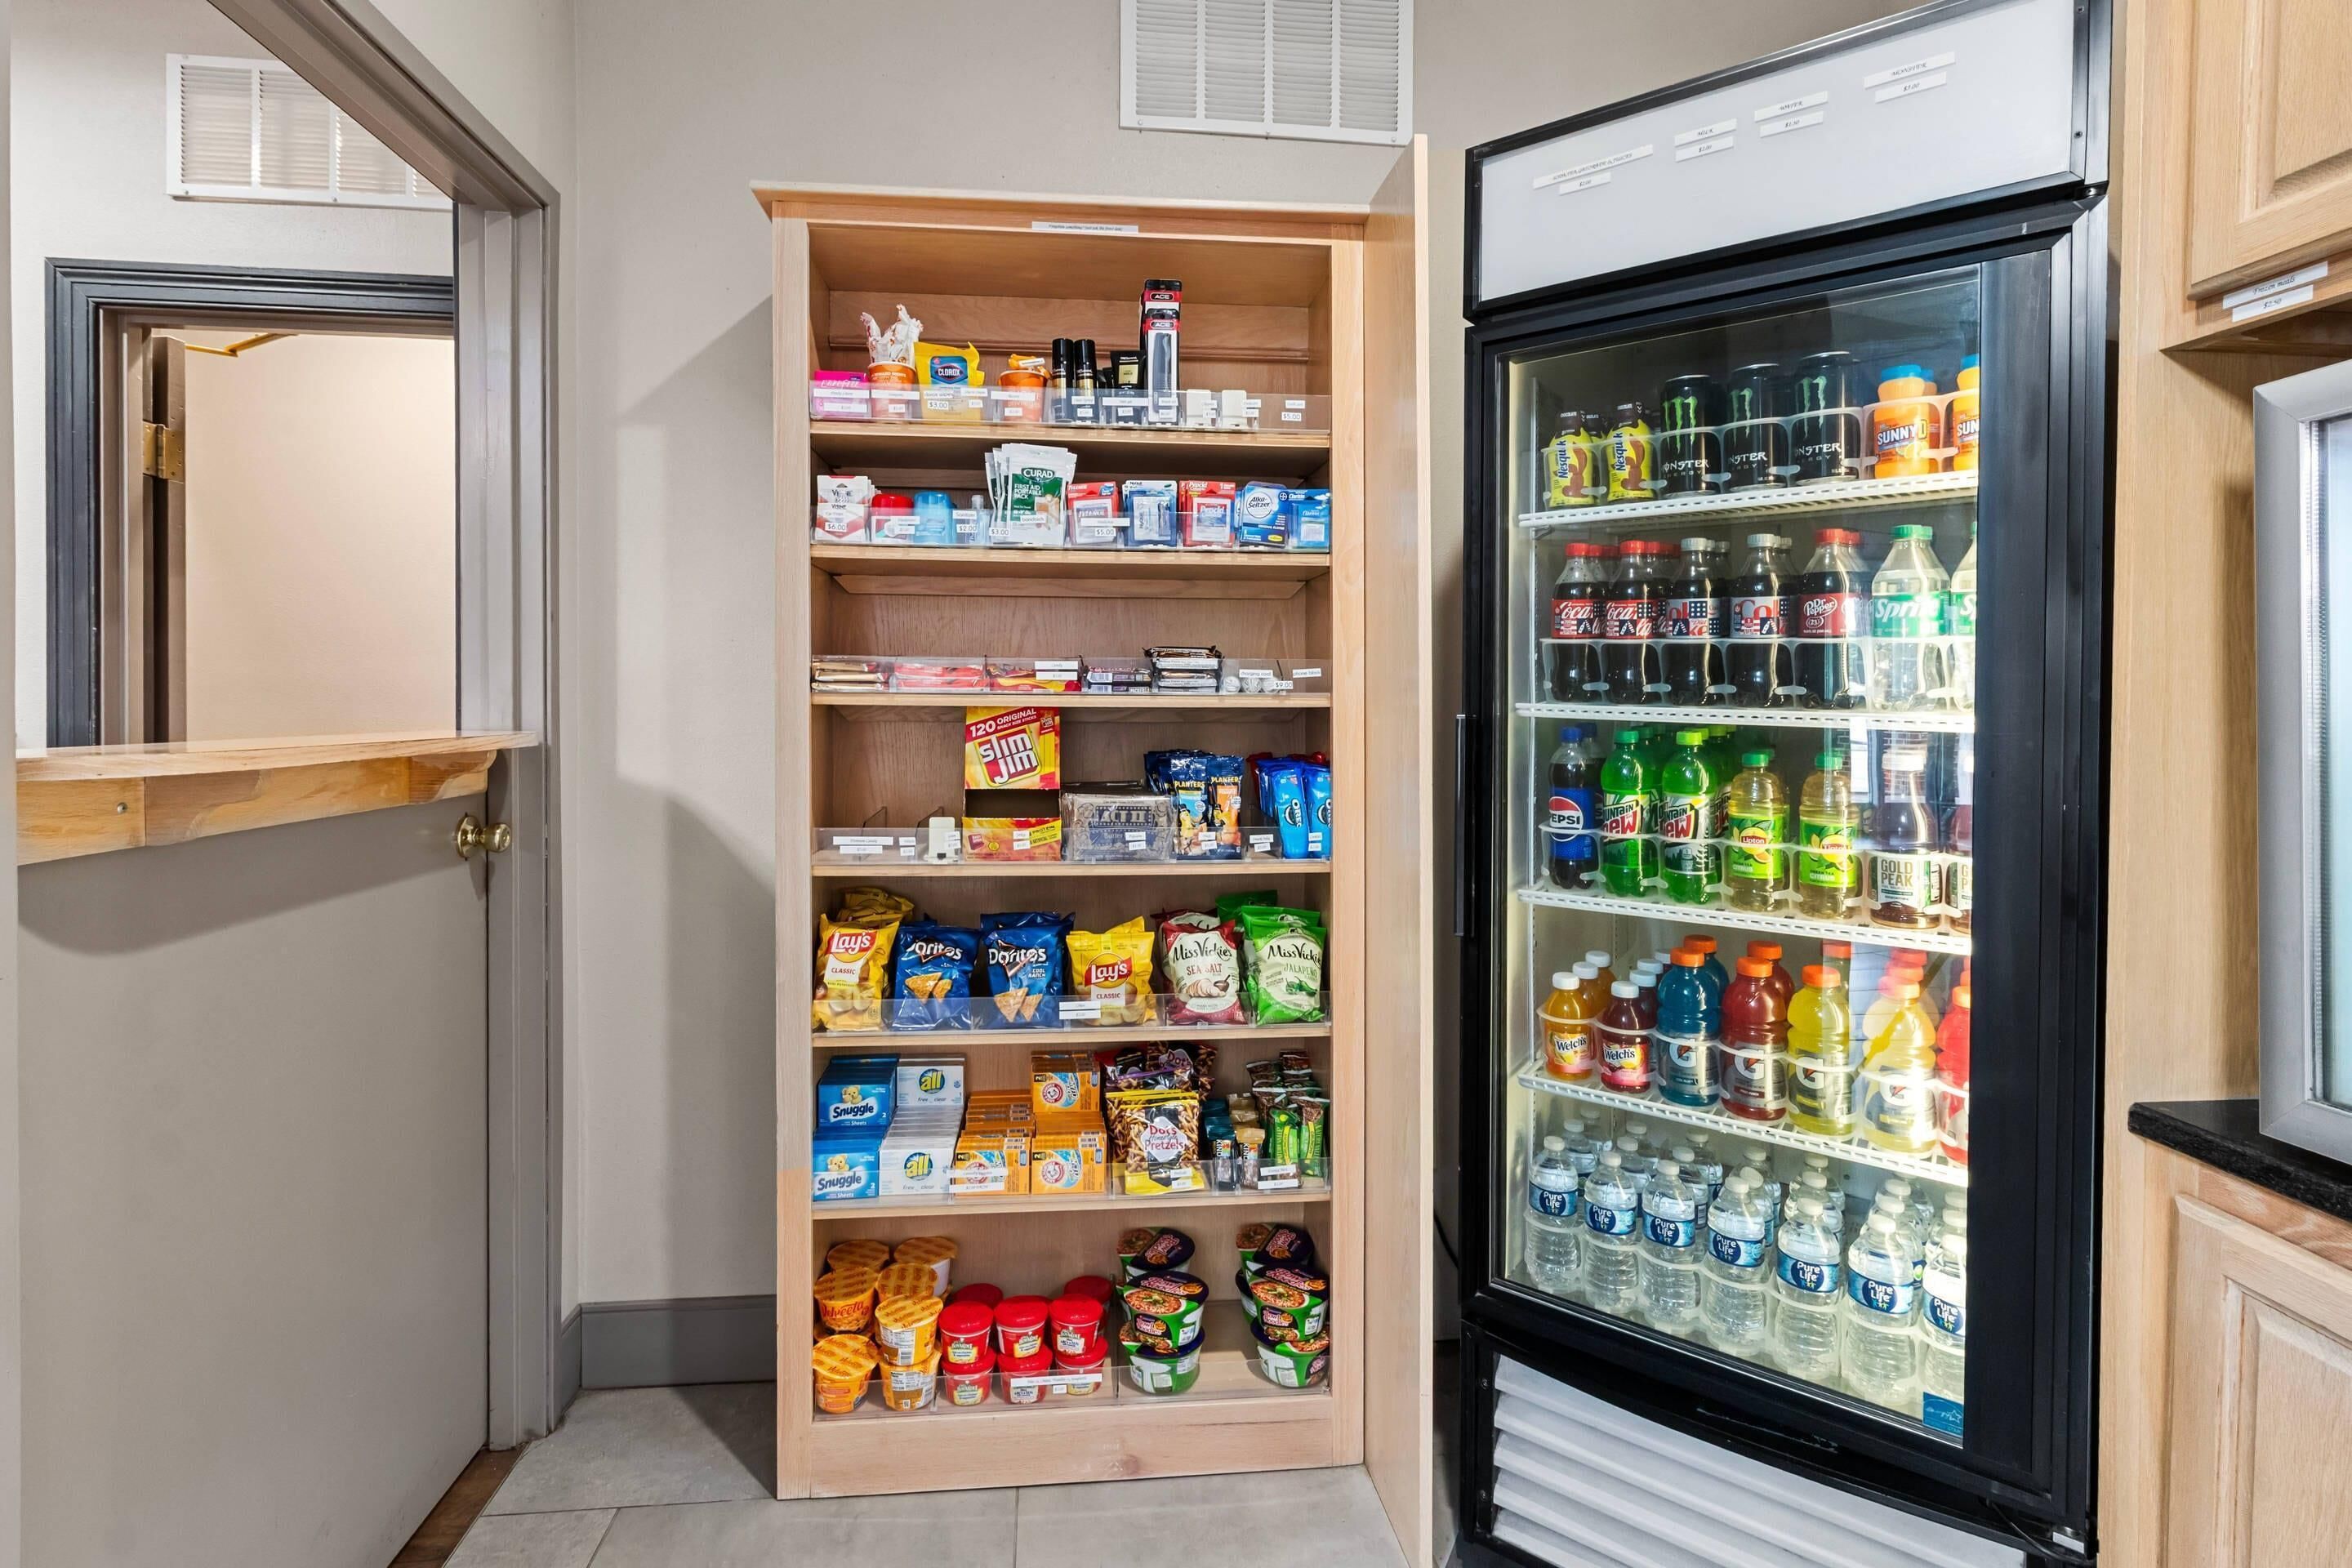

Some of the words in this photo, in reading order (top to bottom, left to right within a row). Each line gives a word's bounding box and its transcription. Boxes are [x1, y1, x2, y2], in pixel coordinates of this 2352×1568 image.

[2252, 283, 2275, 295] Frozen
[938, 368, 960, 377] CLOROX
[1957, 419, 1980, 437] SUN
[1878, 425, 1917, 446] SUNNY
[1615, 432, 1626, 471] Nesquk
[1557, 439, 1569, 479] Nesquk
[1023, 469, 1053, 479] CURAD
[1559, 601, 1593, 620] Coca
[1806, 600, 1835, 617] Pepper
[997, 708, 1037, 724] ORIGINAL
[969, 720, 996, 737] 120
[979, 733, 1033, 764] slim
[993, 751, 1039, 784] jim
[1174, 780, 1205, 788] PLANTERS
[1552, 813, 1580, 825] EPSI
[1743, 836, 1765, 844] Lipton
[1881, 859, 1913, 875] GOLD
[1881, 872, 1913, 887] PEAK
[831, 931, 871, 954] Lay's
[989, 947, 1047, 965] Doritos
[831, 967, 857, 975] CLASSIC
[1091, 960, 1130, 984] Lay's
[1187, 966, 1202, 976] SEA
[1556, 1035, 1587, 1053] Welch's
[1604, 1048, 1636, 1061] Welch's
[920, 1070, 944, 1091] all
[832, 1102, 875, 1119] Snuggle
[1144, 1138, 1184, 1151] Pretzels
[905, 1154, 931, 1176] all
[817, 1173, 862, 1192] Snuggle
[1544, 1192, 1562, 1201] Pure
[1545, 1198, 1561, 1209] Life
[1592, 1205, 1612, 1217] Pure
[1594, 1214, 1610, 1225] Life
[1655, 1218, 1675, 1230] Pure
[1657, 1226, 1673, 1238] Life
[1717, 1235, 1736, 1247] Pure
[1718, 1244, 1734, 1255] Life
[1797, 1262, 1820, 1274] Pure
[1800, 1270, 1818, 1282] Life
[1869, 1281, 1894, 1294] Pure
[1870, 1290, 1891, 1303] Life
[1934, 1298, 1958, 1313] Pure
[1936, 1308, 1957, 1322] Life
